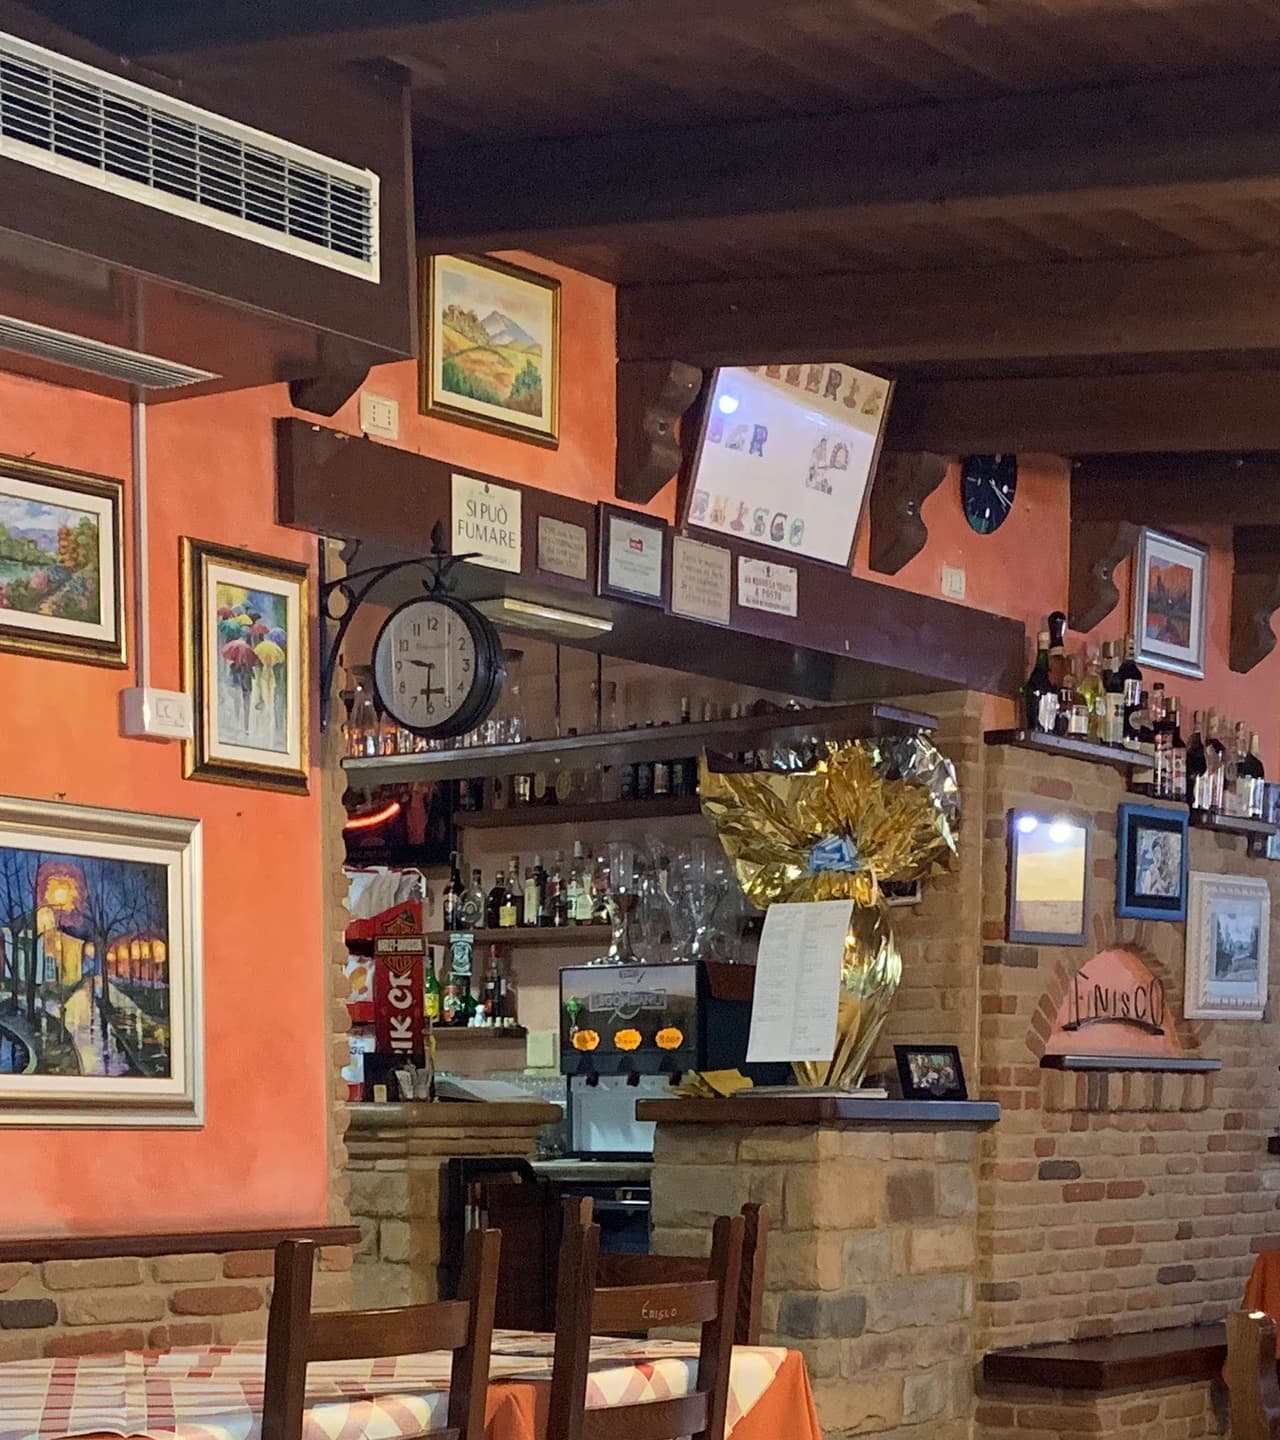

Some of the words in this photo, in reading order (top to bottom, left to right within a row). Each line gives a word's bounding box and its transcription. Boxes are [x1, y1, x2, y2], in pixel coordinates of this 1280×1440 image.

[466, 499, 477, 518] SI
[481, 502, 508, 525] PUÒ
[458, 519, 517, 549] FUMARE
[413, 623, 420, 636] 11
[427, 617, 439, 631] 12
[447, 623, 451, 635] 1
[399, 640, 409, 652] 10
[458, 637, 465, 650] 2
[395, 661, 402, 673] 9
[462, 659, 470, 672] 3
[399, 681, 406, 694] 8
[457, 682, 464, 693] 4
[411, 696, 418, 708] 7
[427, 701, 435, 714] 6
[389, 1015, 414, 1055] IK
